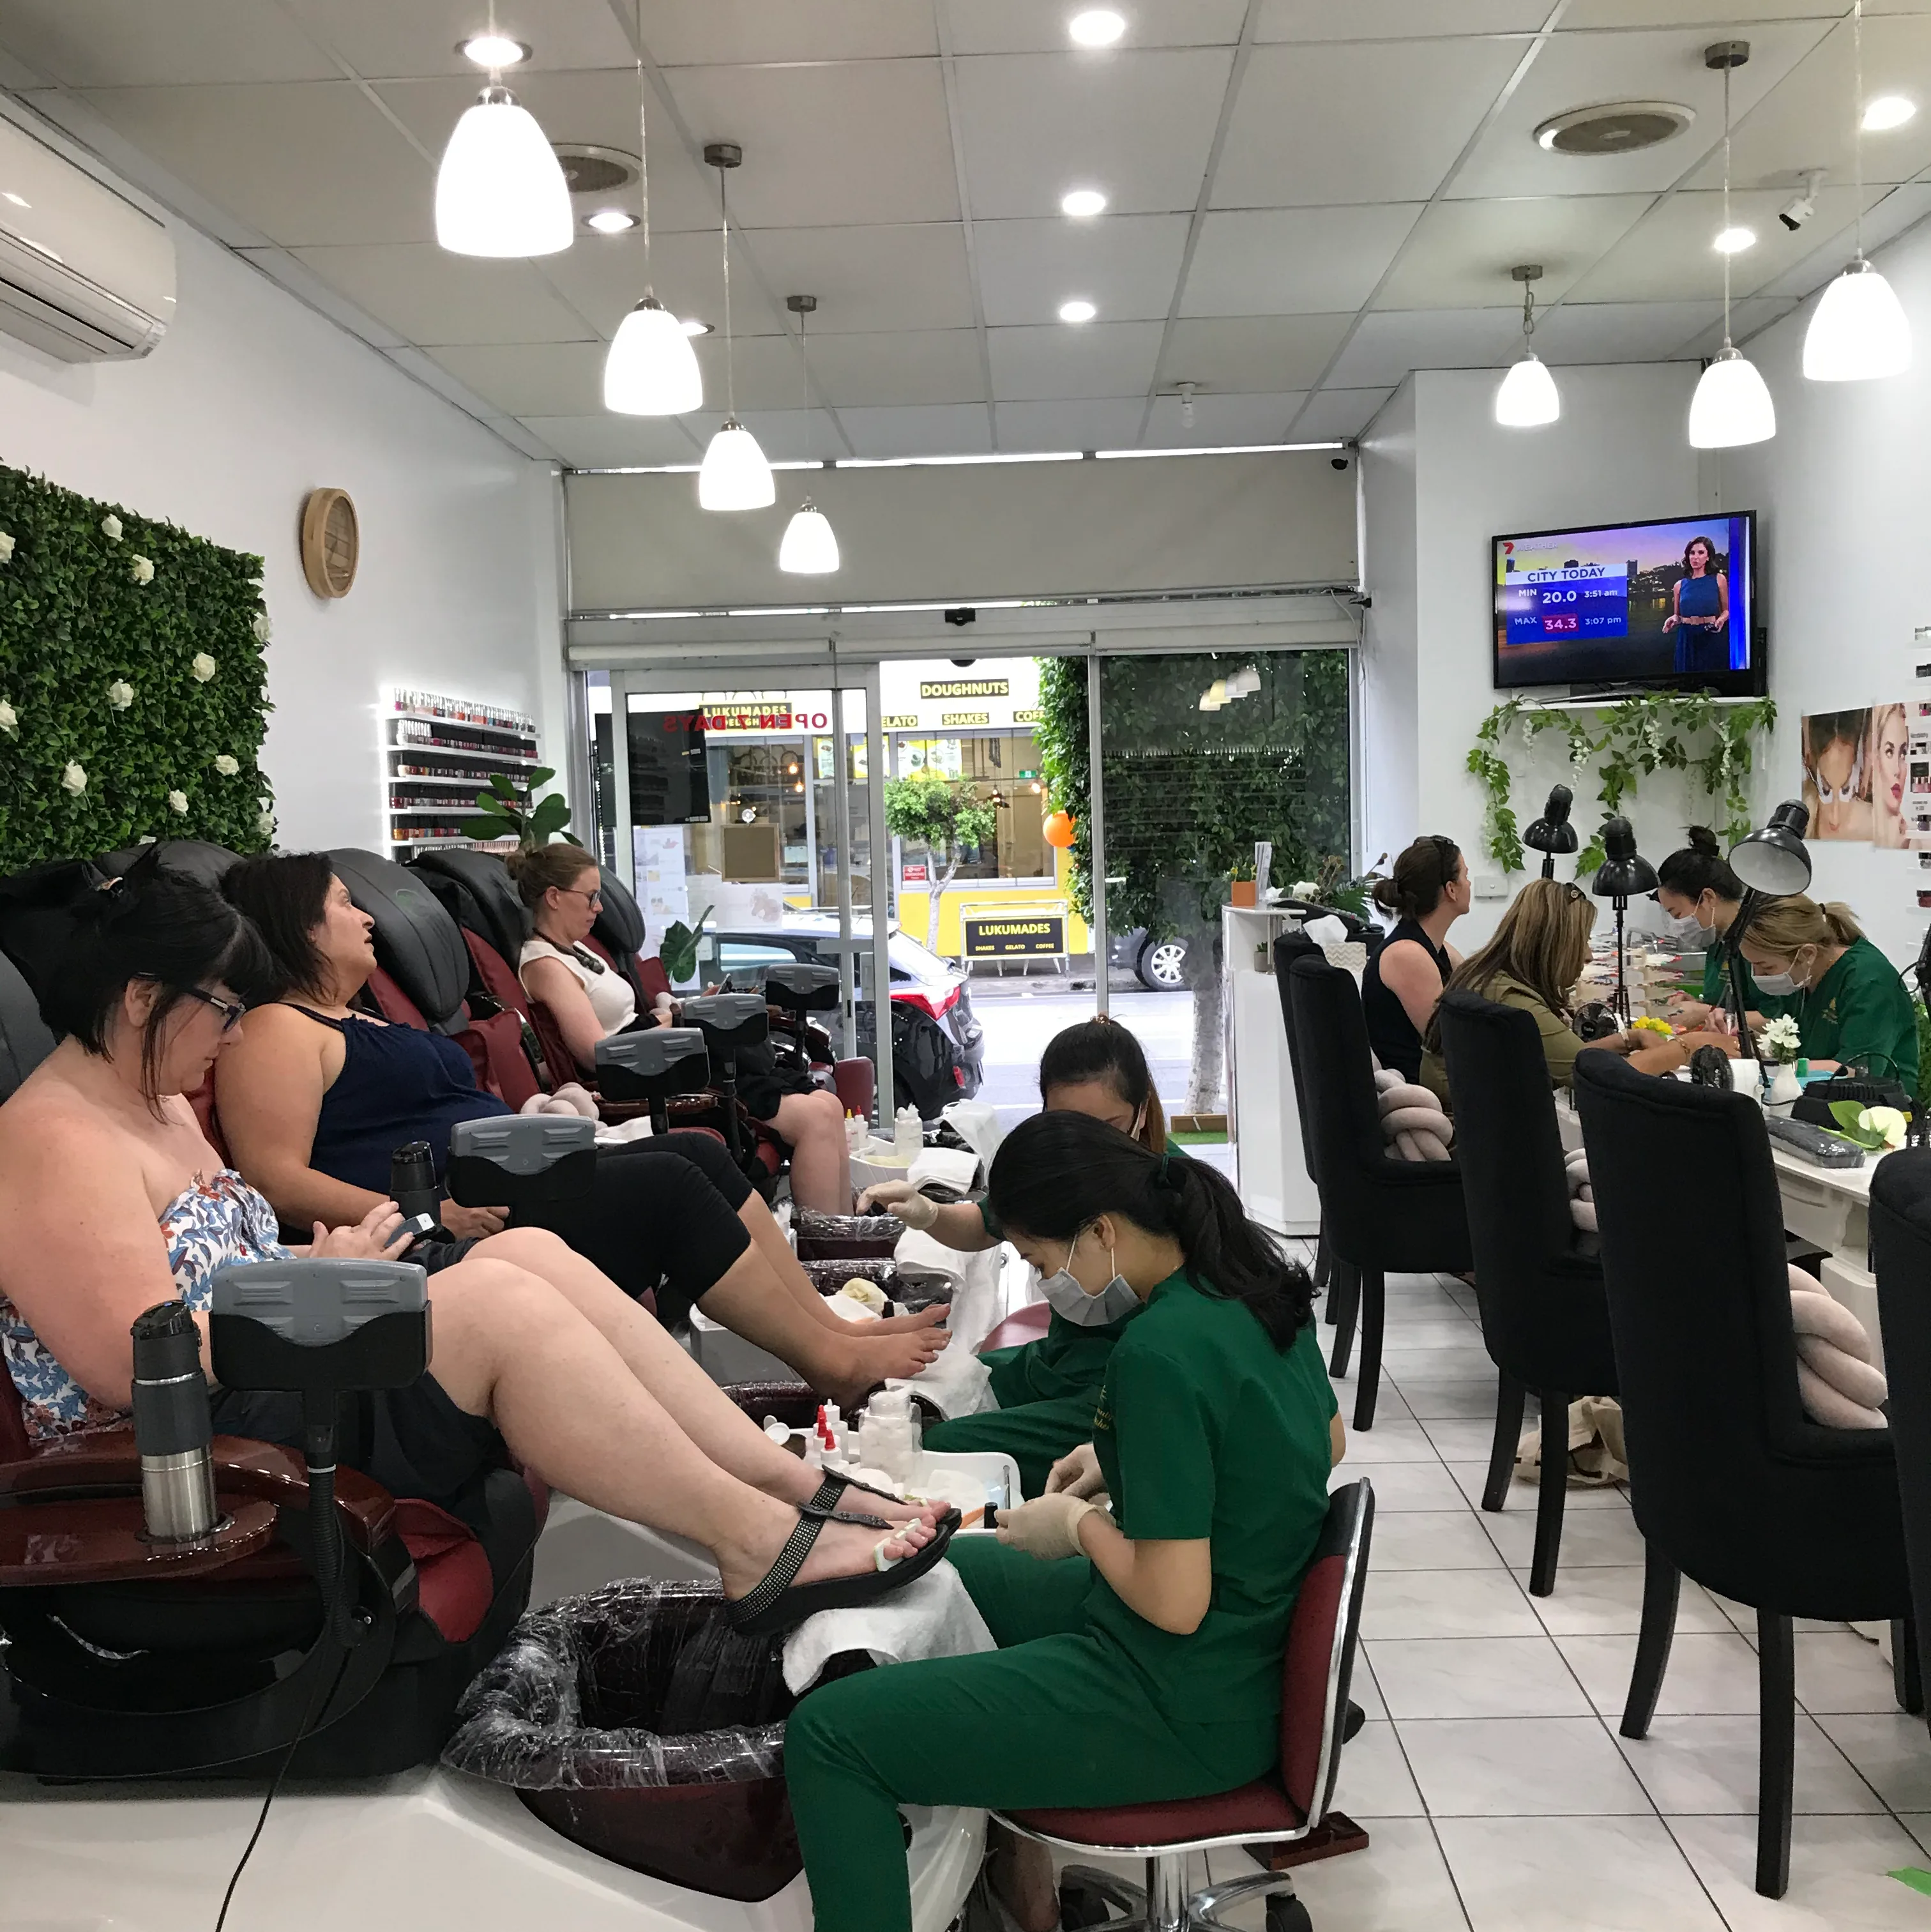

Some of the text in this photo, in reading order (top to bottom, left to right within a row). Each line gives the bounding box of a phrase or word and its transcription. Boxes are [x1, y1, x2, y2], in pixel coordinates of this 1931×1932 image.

[1503, 542, 1515, 554] 7
[1527, 567, 1606, 582] CITY TODAY
[1518, 588, 1537, 597] MIN
[1542, 590, 1577, 604] 20.0
[1584, 589, 1602, 598] 3:51
[1515, 616, 1622, 630] MAX 34.3 3:07 pm
[921, 682, 1008, 697] DOUGHNUTS
[704, 705, 787, 718] LUKUMADES
[881, 711, 1045, 727] ELATO SHAKES COFF
[979, 923, 1050, 936] LUKUMADES
